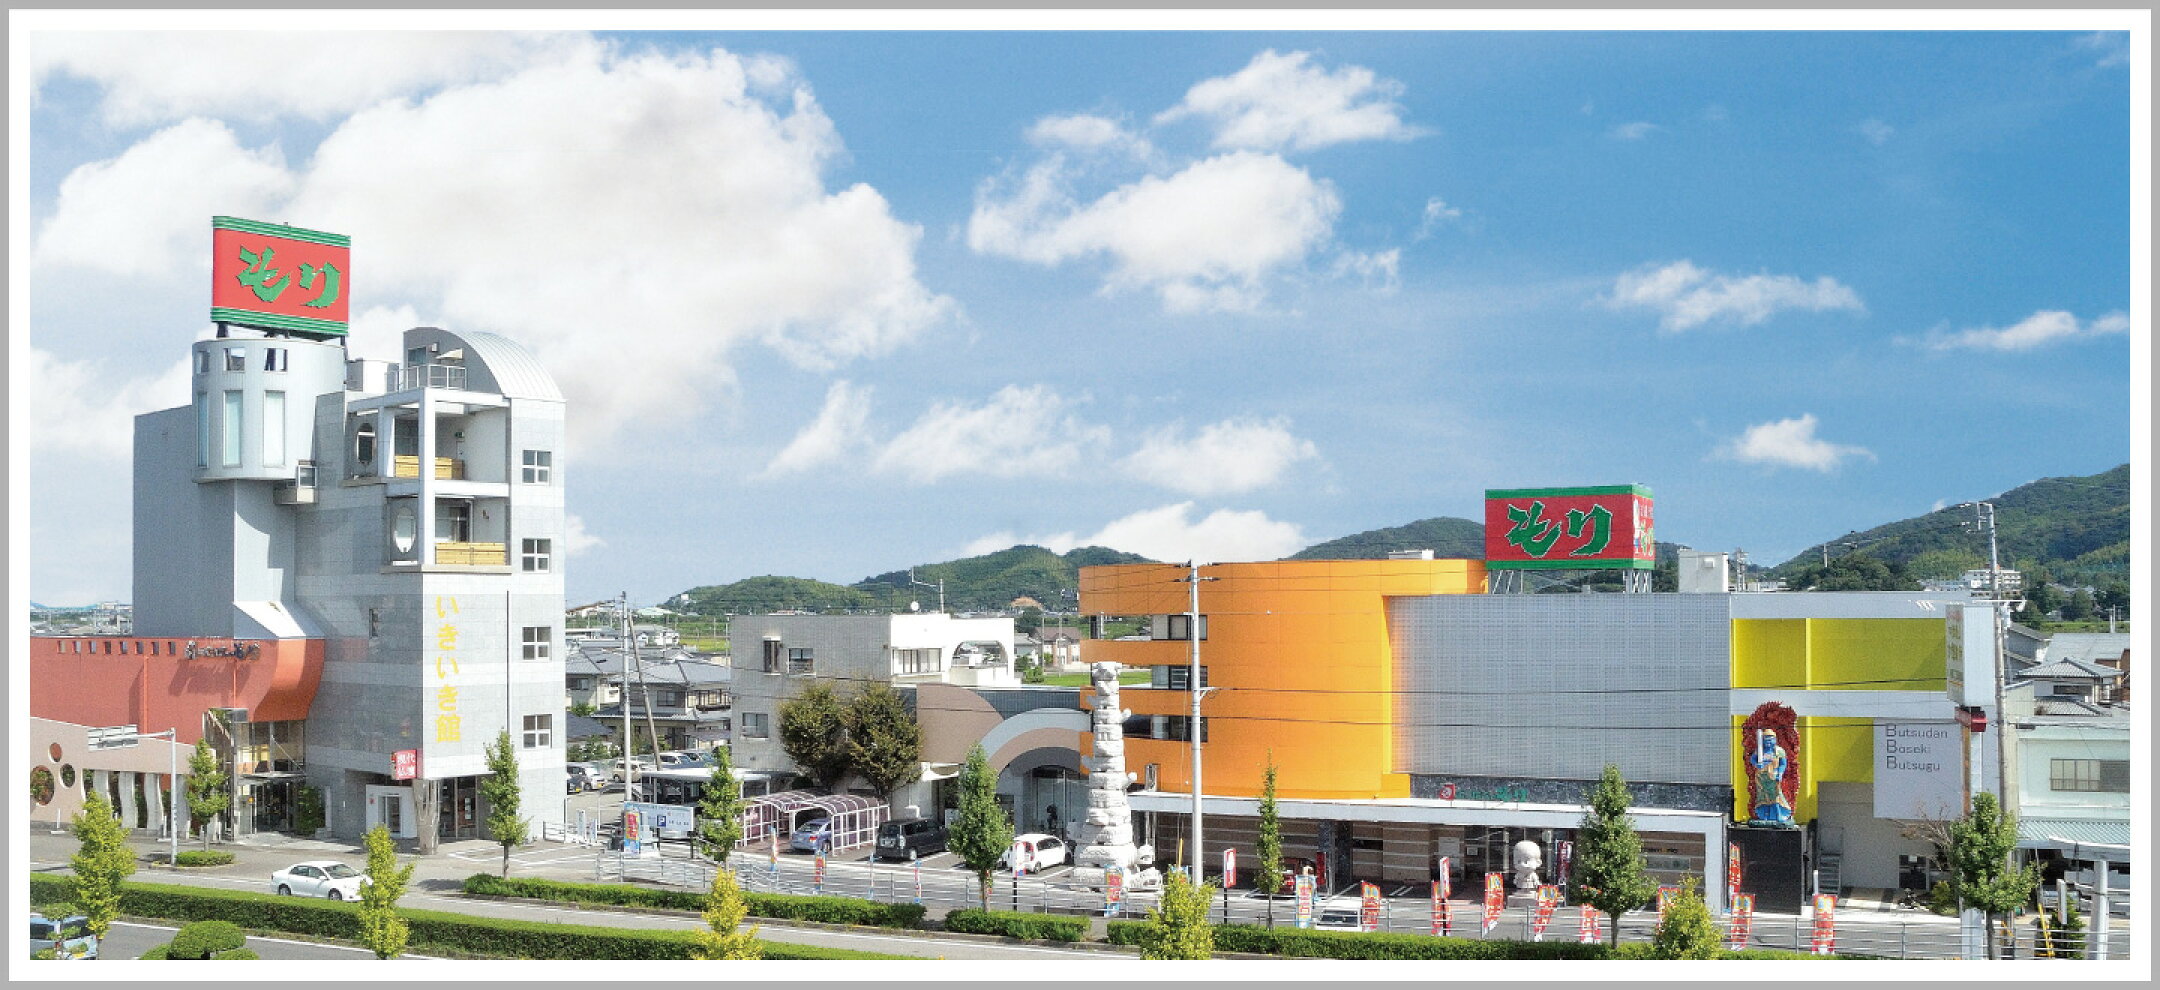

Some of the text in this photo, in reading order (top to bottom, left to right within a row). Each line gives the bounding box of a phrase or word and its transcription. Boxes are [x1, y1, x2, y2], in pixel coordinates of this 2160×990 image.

[236, 246, 340, 309] もり
[1505, 501, 1612, 558] もり
[435, 595, 461, 743] いきいき館
[1886, 723, 1948, 739] Butsudan
[1887, 739, 1931, 753] Boseki
[1887, 756, 1940, 772] Butsugu
